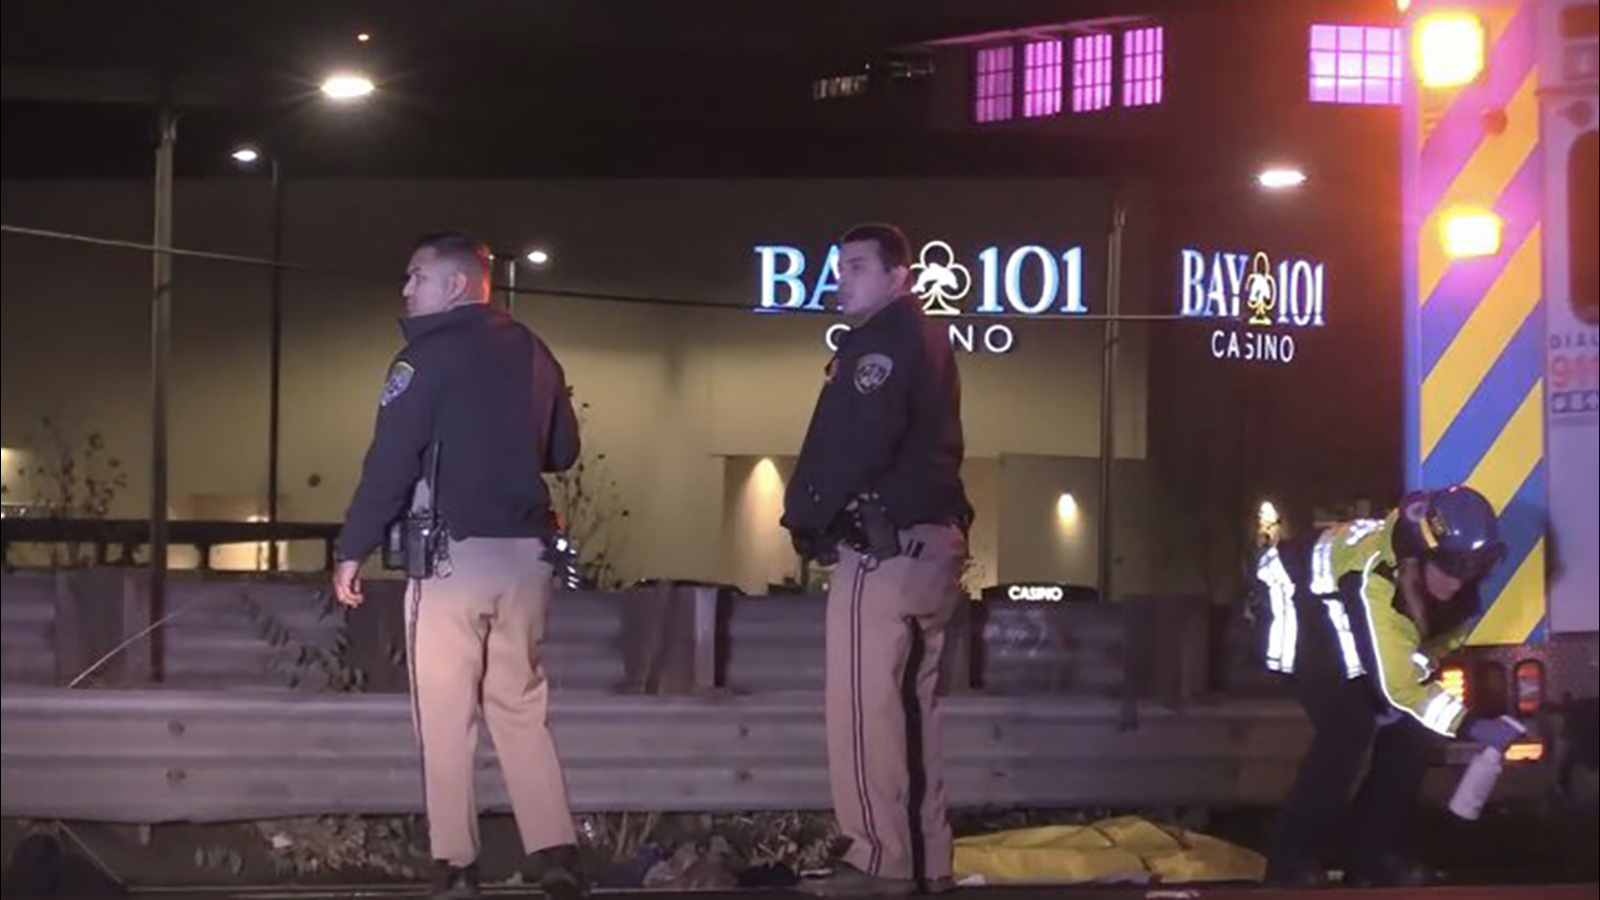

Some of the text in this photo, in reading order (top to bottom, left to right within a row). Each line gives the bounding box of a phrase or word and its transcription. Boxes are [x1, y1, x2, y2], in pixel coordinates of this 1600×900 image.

[754, 245, 1088, 314] BA 101
[1181, 249, 1325, 326] BAY 101
[825, 324, 1014, 352] CNO
[1211, 329, 1295, 363] CASINO
[1008, 585, 1063, 601] CASINO
